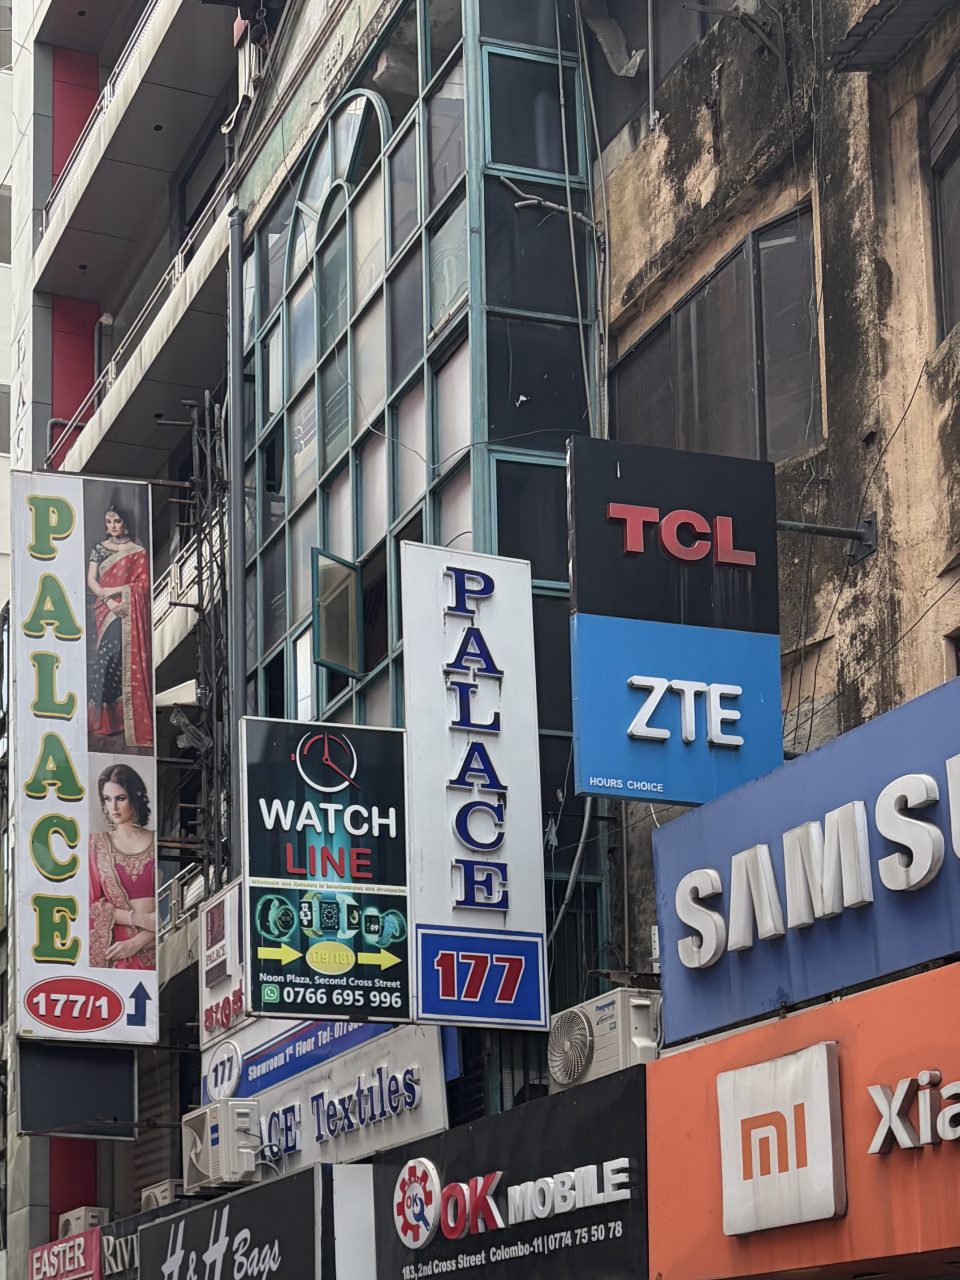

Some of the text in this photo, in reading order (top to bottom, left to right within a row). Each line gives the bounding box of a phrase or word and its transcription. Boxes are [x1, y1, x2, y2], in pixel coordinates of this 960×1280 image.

[607, 502, 756, 566] TCL
[22, 494, 85, 965] PALACE
[627, 675, 744, 747] ZTE
[443, 566, 509, 911] PALACE
[589, 776, 664, 793] HOURS CHOICE
[259, 797, 397, 839] WATCH
[286, 843, 373, 878] LINE
[259, 973, 401, 988] Noon Plaza, Second Cross Street
[283, 988, 401, 1007] 0766 695 996
[434, 950, 526, 1004] 177
[32, 991, 111, 1020] 177/1
[212, 1056, 234, 1088] 177
[248, 1054, 285, 1081] Showroom
[295, 1037, 315, 1057] Floor
[318, 1027, 333, 1047] Tel:
[311, 1064, 421, 1143] Textiles
[405, 1191, 419, 1208] OK
[441, 1157, 631, 1240] OK MOBILE
[33, 1237, 86, 1280] EASTER
[433, 1258, 456, 1273] Cross
[457, 1252, 486, 1269] Street
[548, 1230, 572, 1250] 0774
[575, 1228, 588, 1245] 75
[591, 1224, 605, 1242] 50
[608, 1221, 623, 1239] 78
